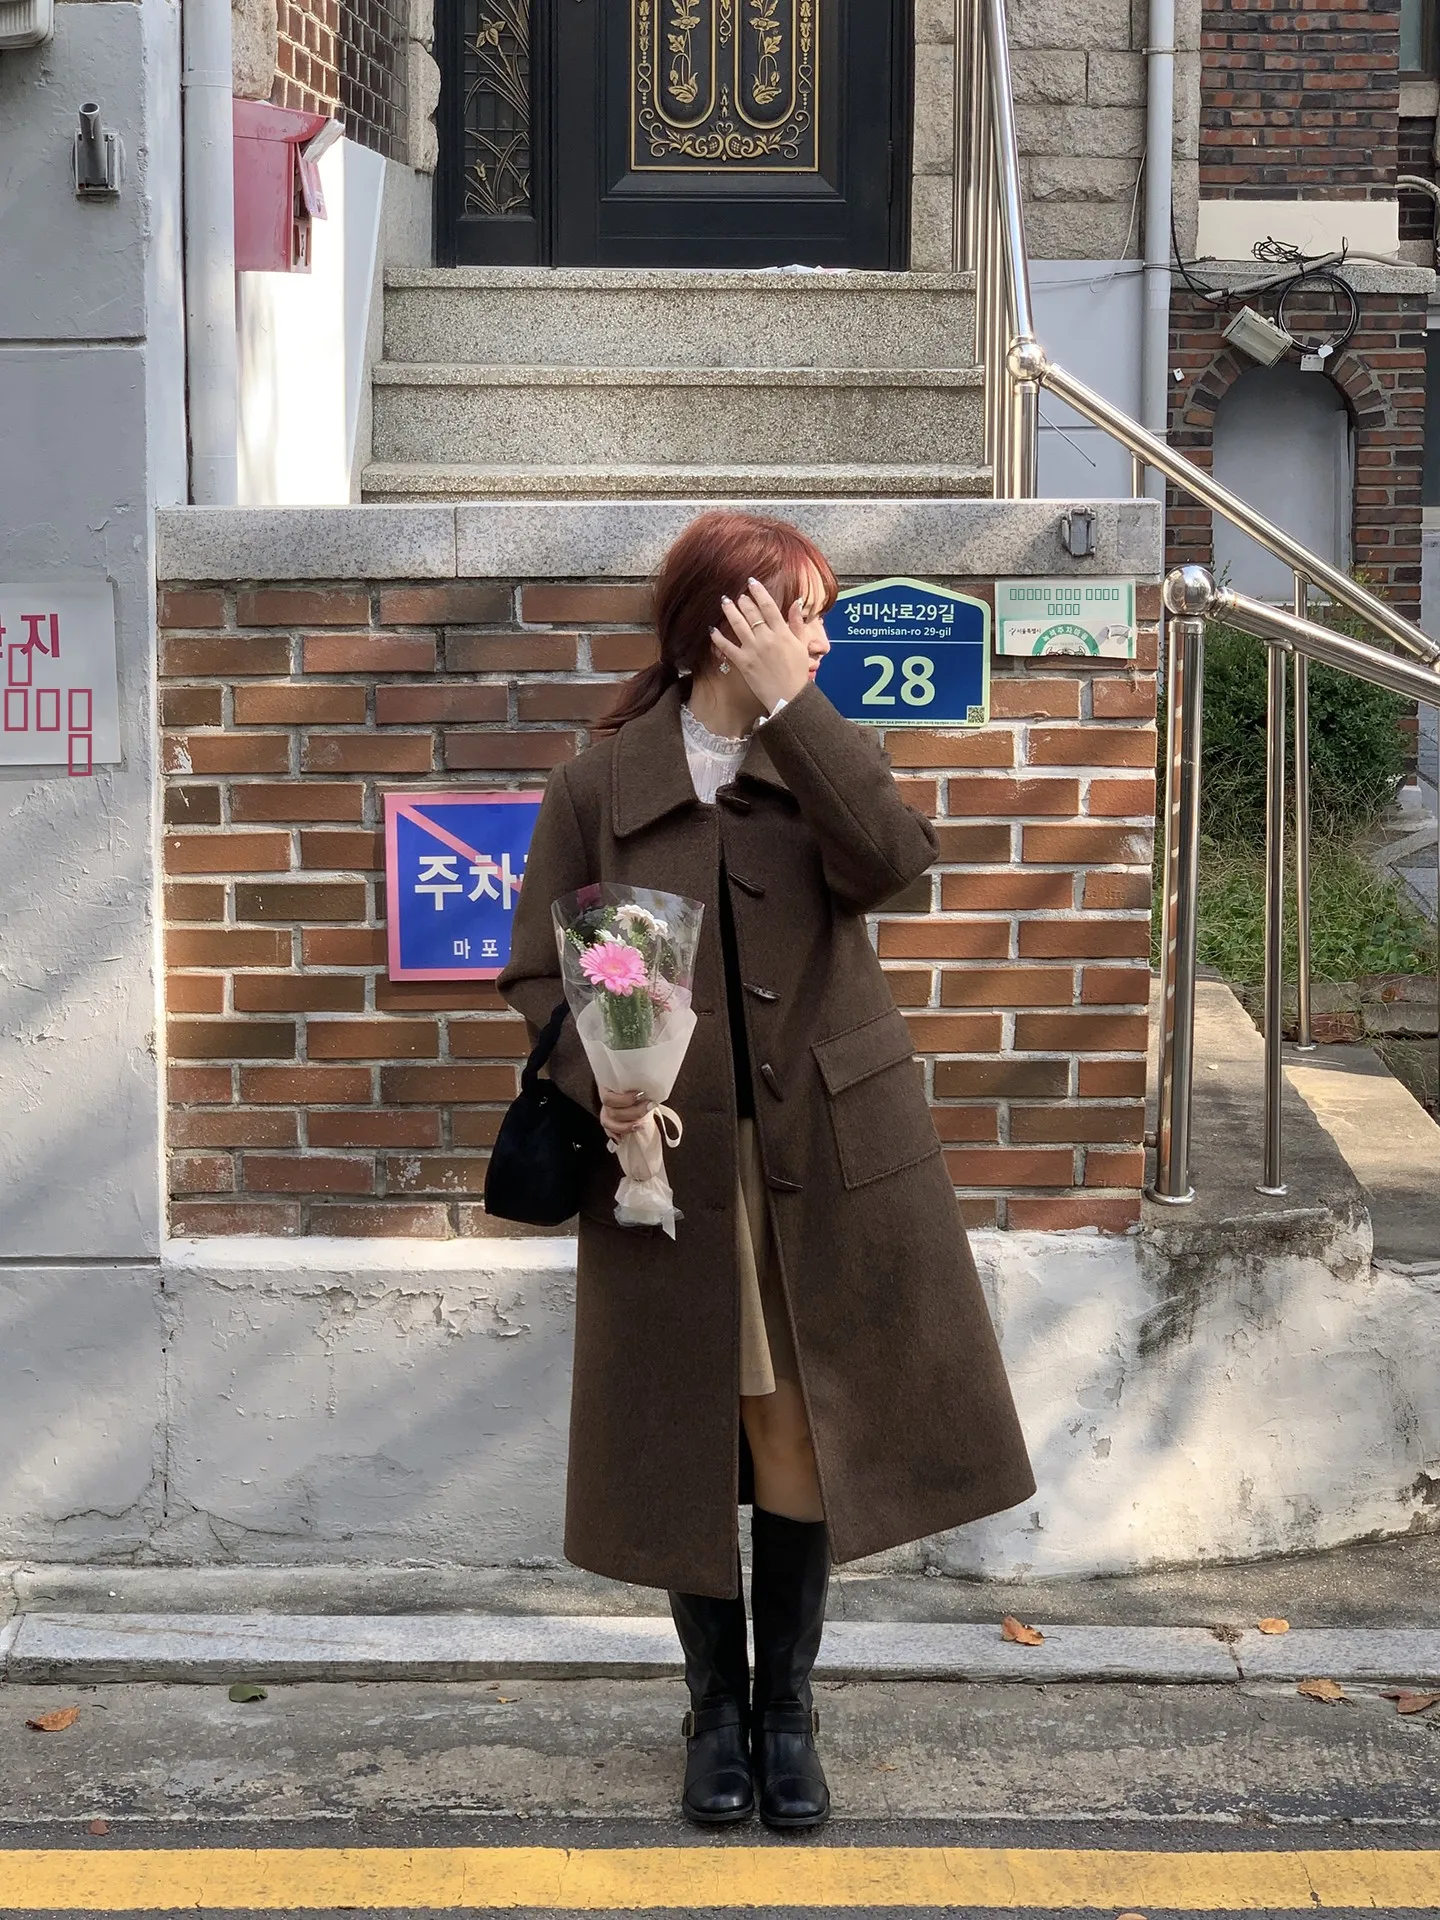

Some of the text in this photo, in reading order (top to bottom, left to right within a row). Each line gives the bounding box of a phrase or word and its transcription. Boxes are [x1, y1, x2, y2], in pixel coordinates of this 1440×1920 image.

[844, 603, 955, 624] 성미산로29길
[847, 626, 951, 638] Seongmisan-ro 29-gil
[861, 655, 936, 706] 28
[414, 853, 528, 912] 주차
